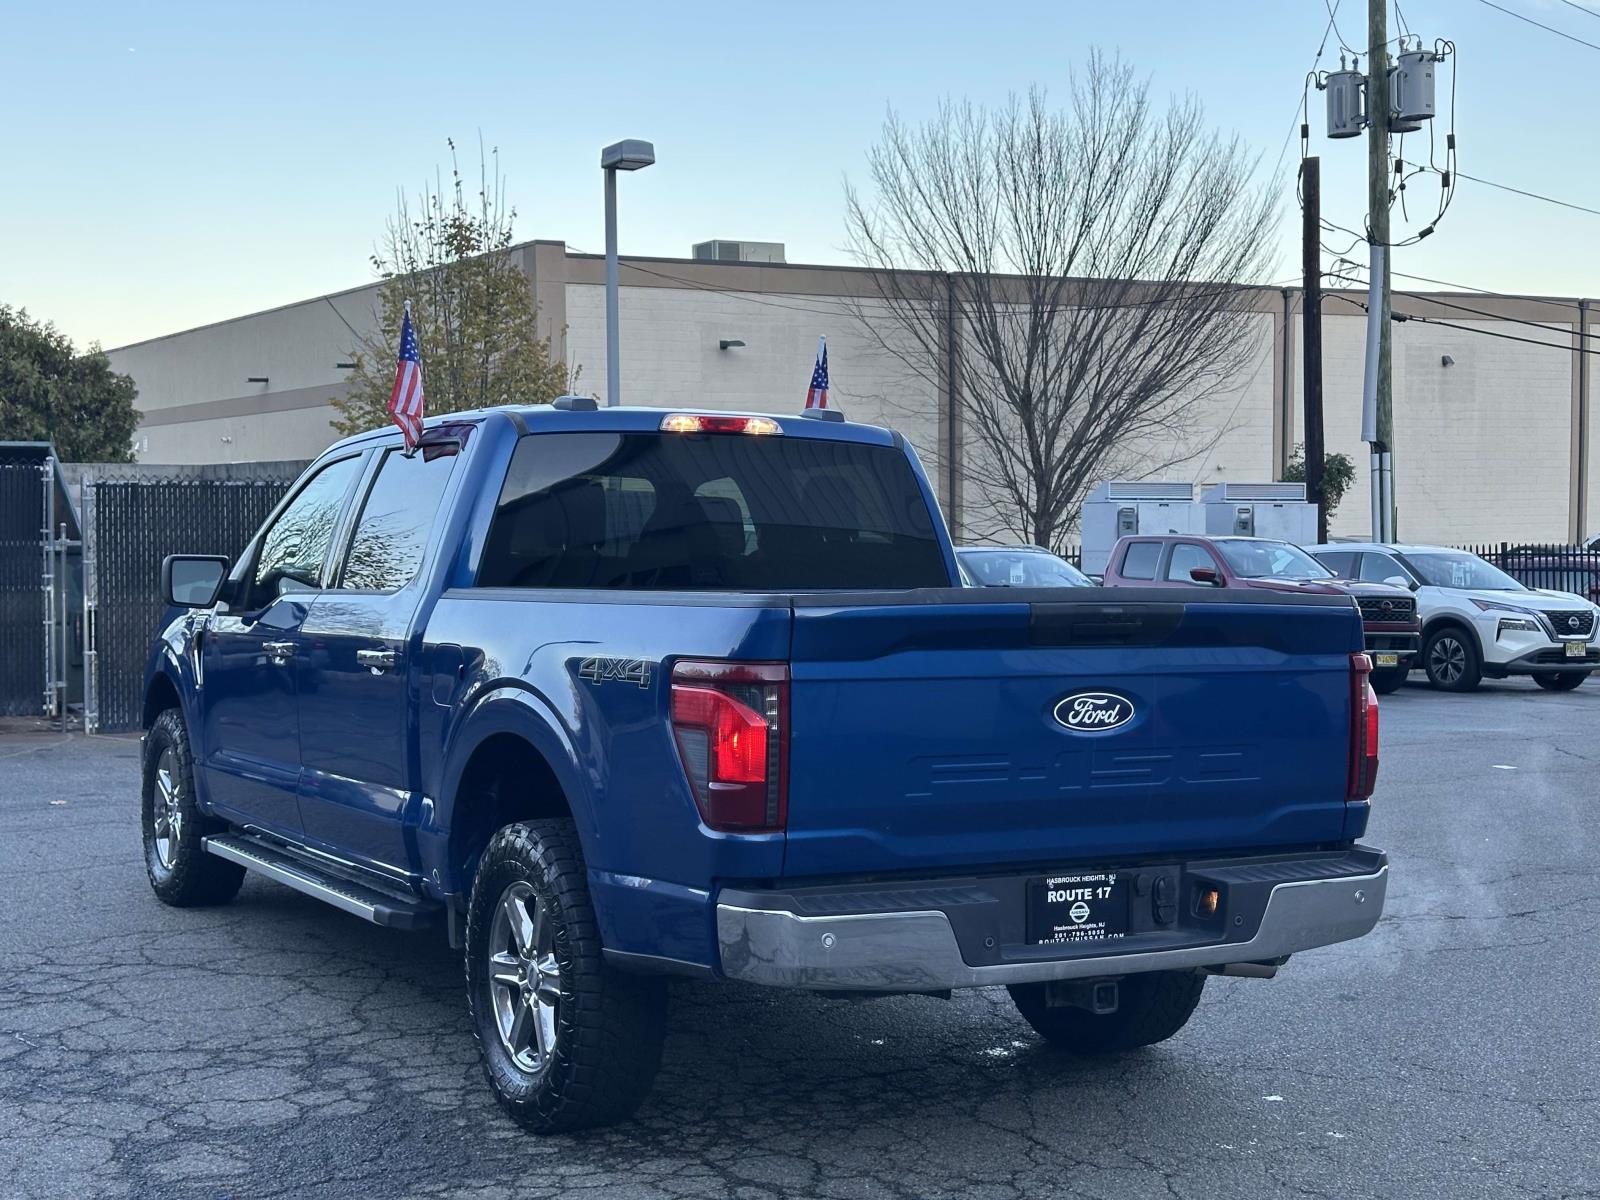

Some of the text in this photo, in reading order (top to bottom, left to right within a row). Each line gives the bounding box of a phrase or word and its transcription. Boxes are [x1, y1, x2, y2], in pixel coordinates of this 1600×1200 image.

[1068, 697, 1121, 724] Ford
[1047, 886, 1112, 903] ROUTE 17
